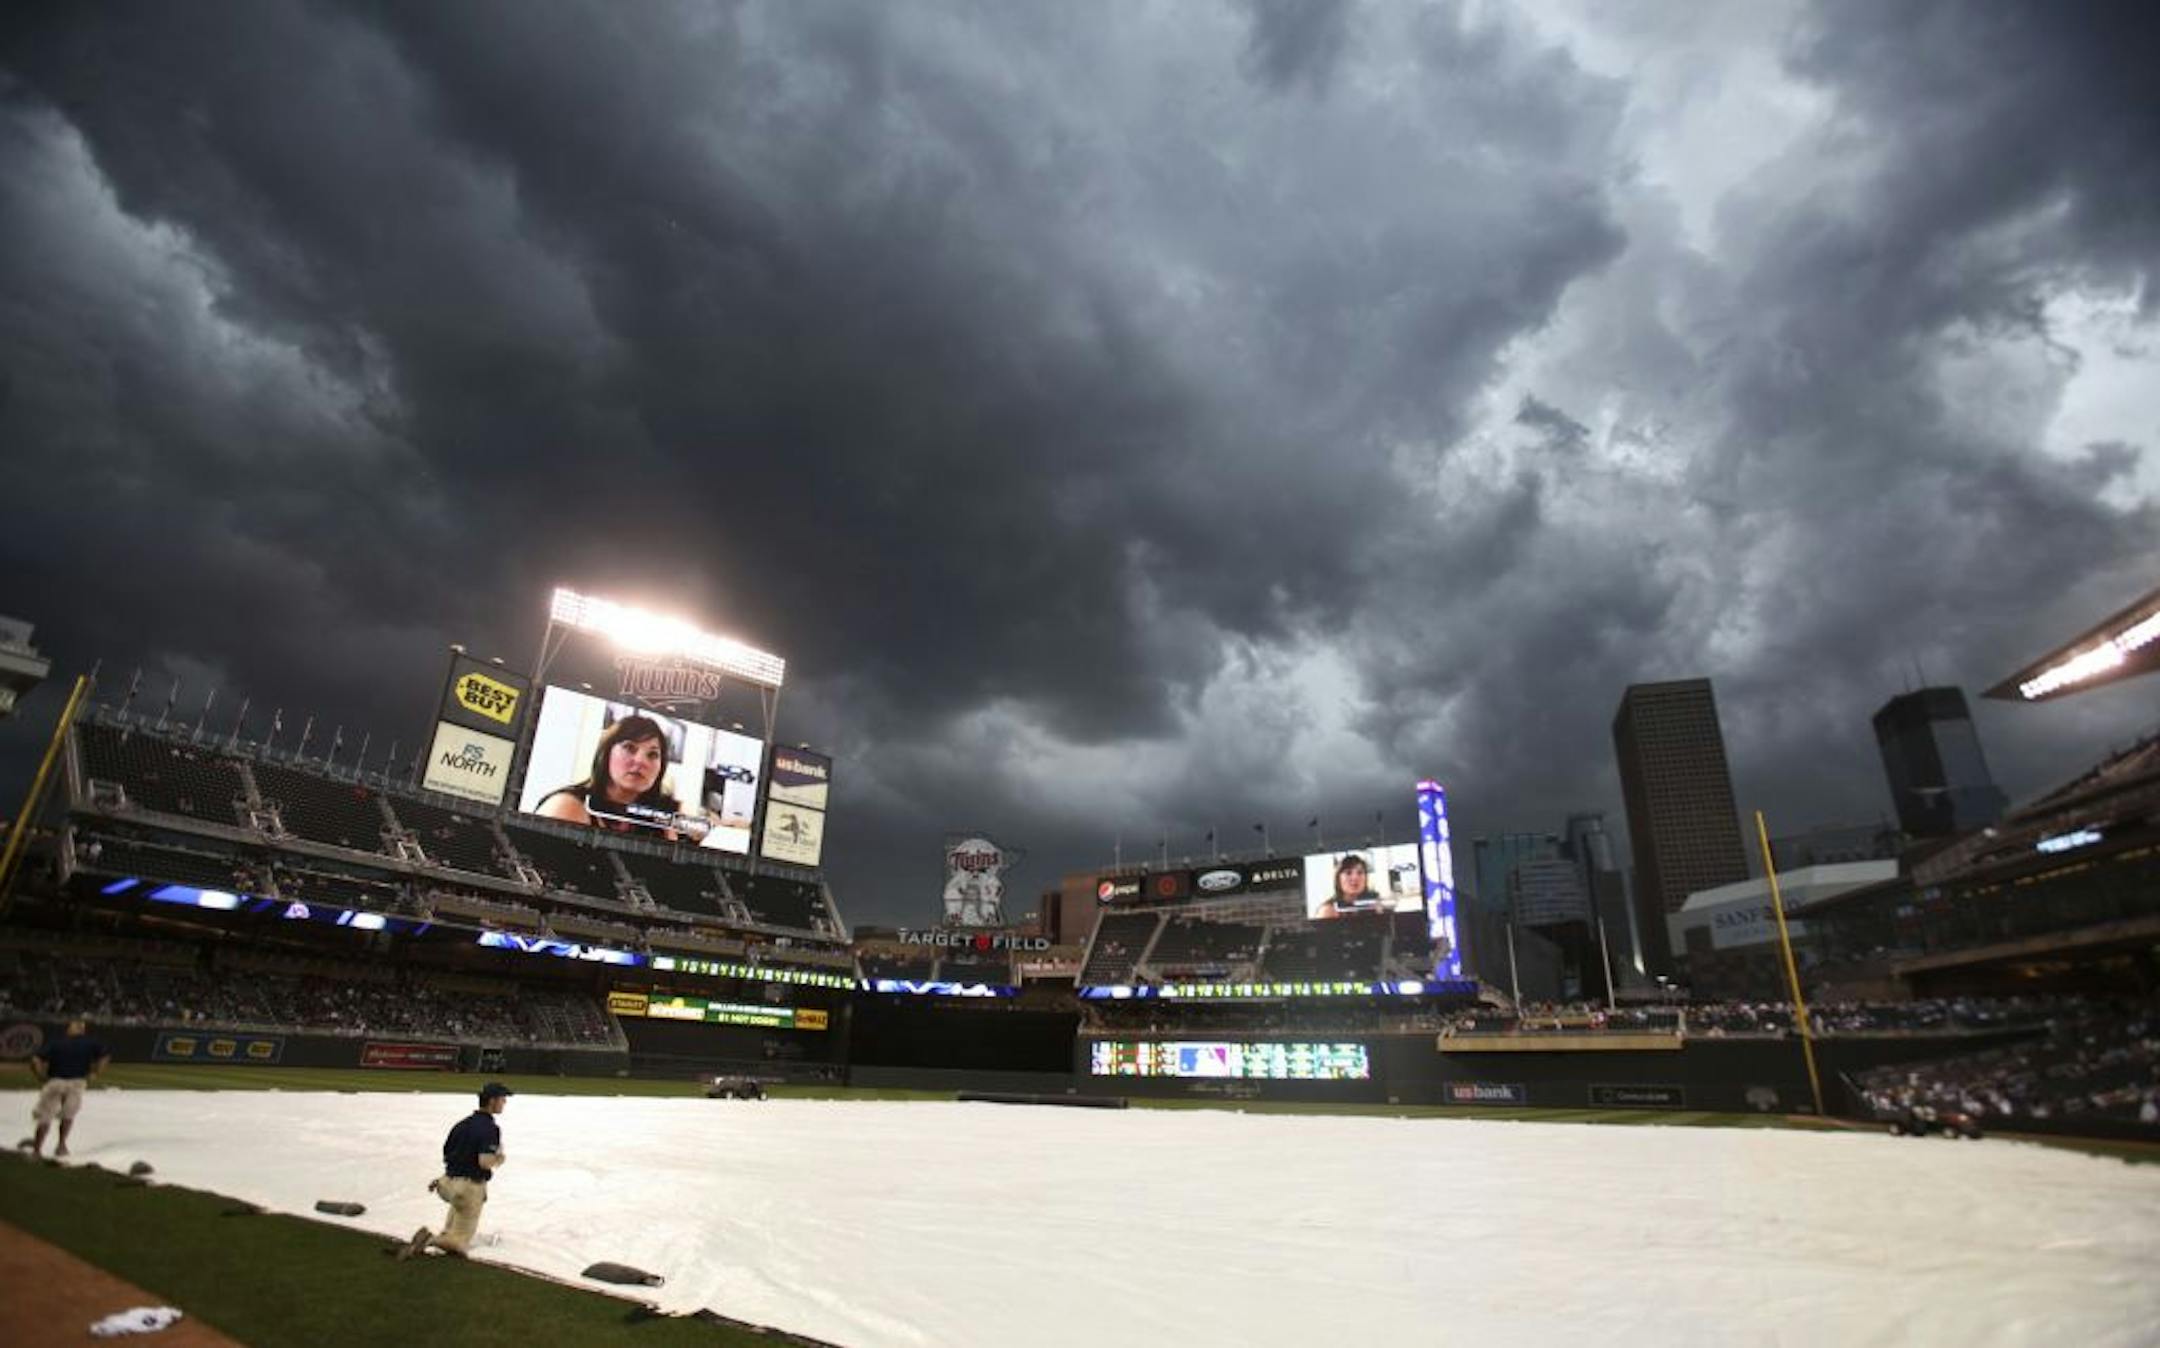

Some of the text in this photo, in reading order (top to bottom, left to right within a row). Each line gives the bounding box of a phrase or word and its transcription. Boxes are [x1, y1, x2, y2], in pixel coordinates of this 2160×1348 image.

[616, 658, 721, 700] Twins
[466, 678, 515, 704] BEST
[464, 692, 507, 714] BUY
[440, 751, 497, 777] NORTH
[950, 850, 999, 873] Twins
[1201, 872, 1238, 890] Ford
[1263, 867, 1299, 881] DELTA
[898, 927, 1049, 951] TARGET FIELD
